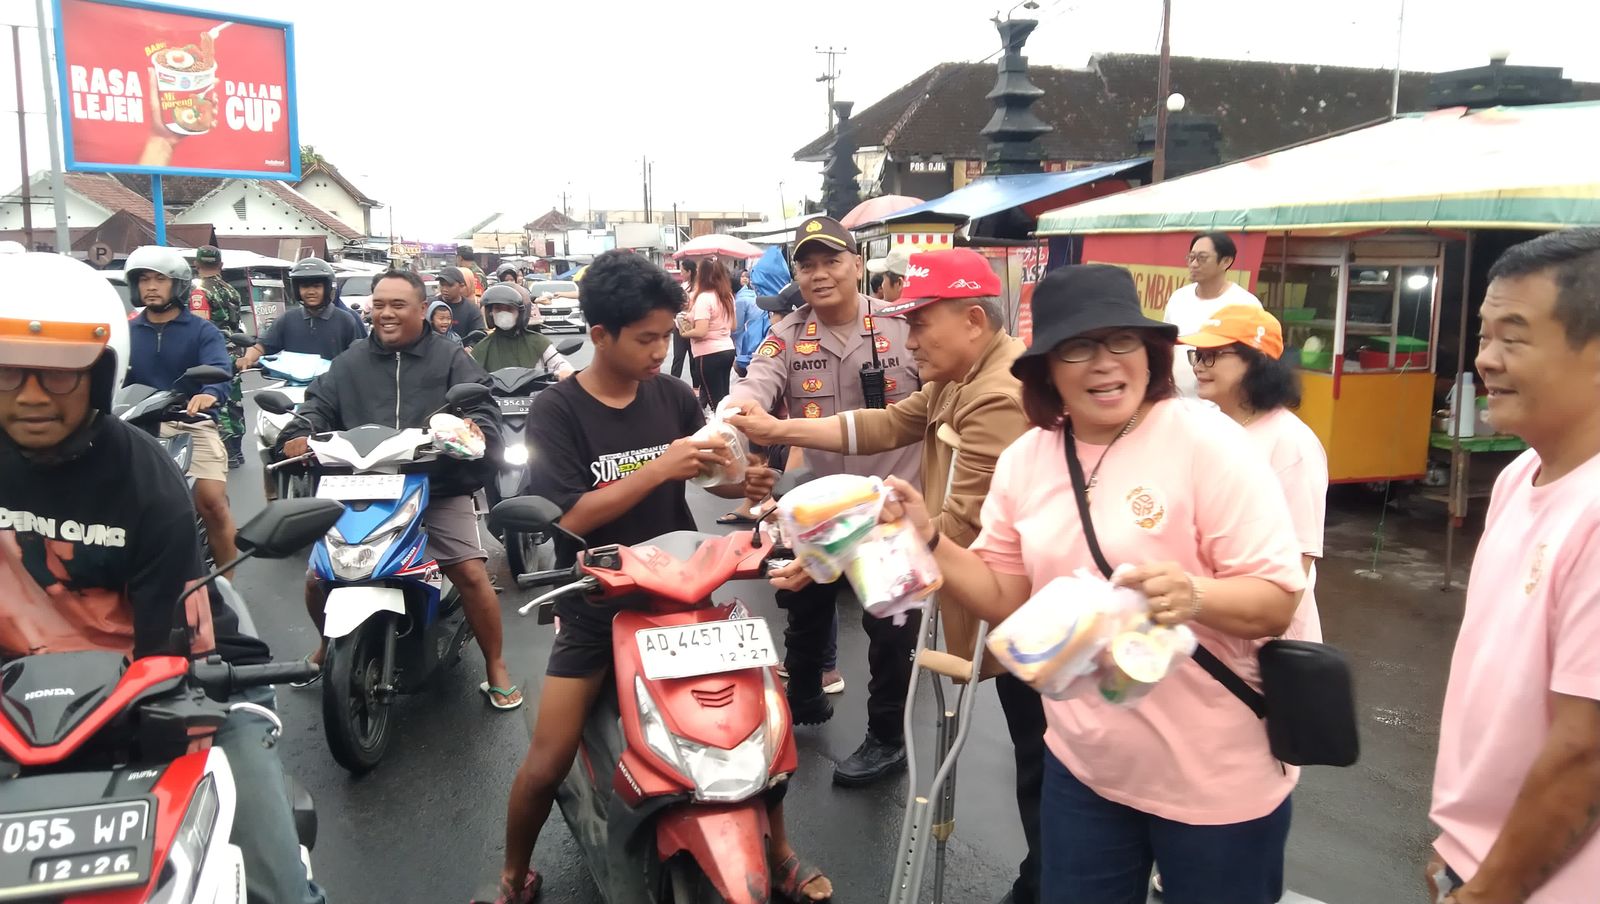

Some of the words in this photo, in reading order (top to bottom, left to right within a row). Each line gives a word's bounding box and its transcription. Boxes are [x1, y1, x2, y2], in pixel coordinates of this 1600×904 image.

[70, 65, 143, 97] RASA
[225, 80, 282, 100] DALAM
[73, 92, 144, 123] LEJEN
[225, 96, 281, 132] CUP
[910, 162, 924, 171] POS
[96, 247, 107, 260] P
[793, 359, 828, 371] GATOT
[646, 633, 669, 652] AD
[678, 626, 722, 649] 4457
[734, 623, 759, 642] VZ
[24, 687, 76, 701] HONDA
[0, 817, 76, 853] 055
[93, 810, 140, 845] WP
